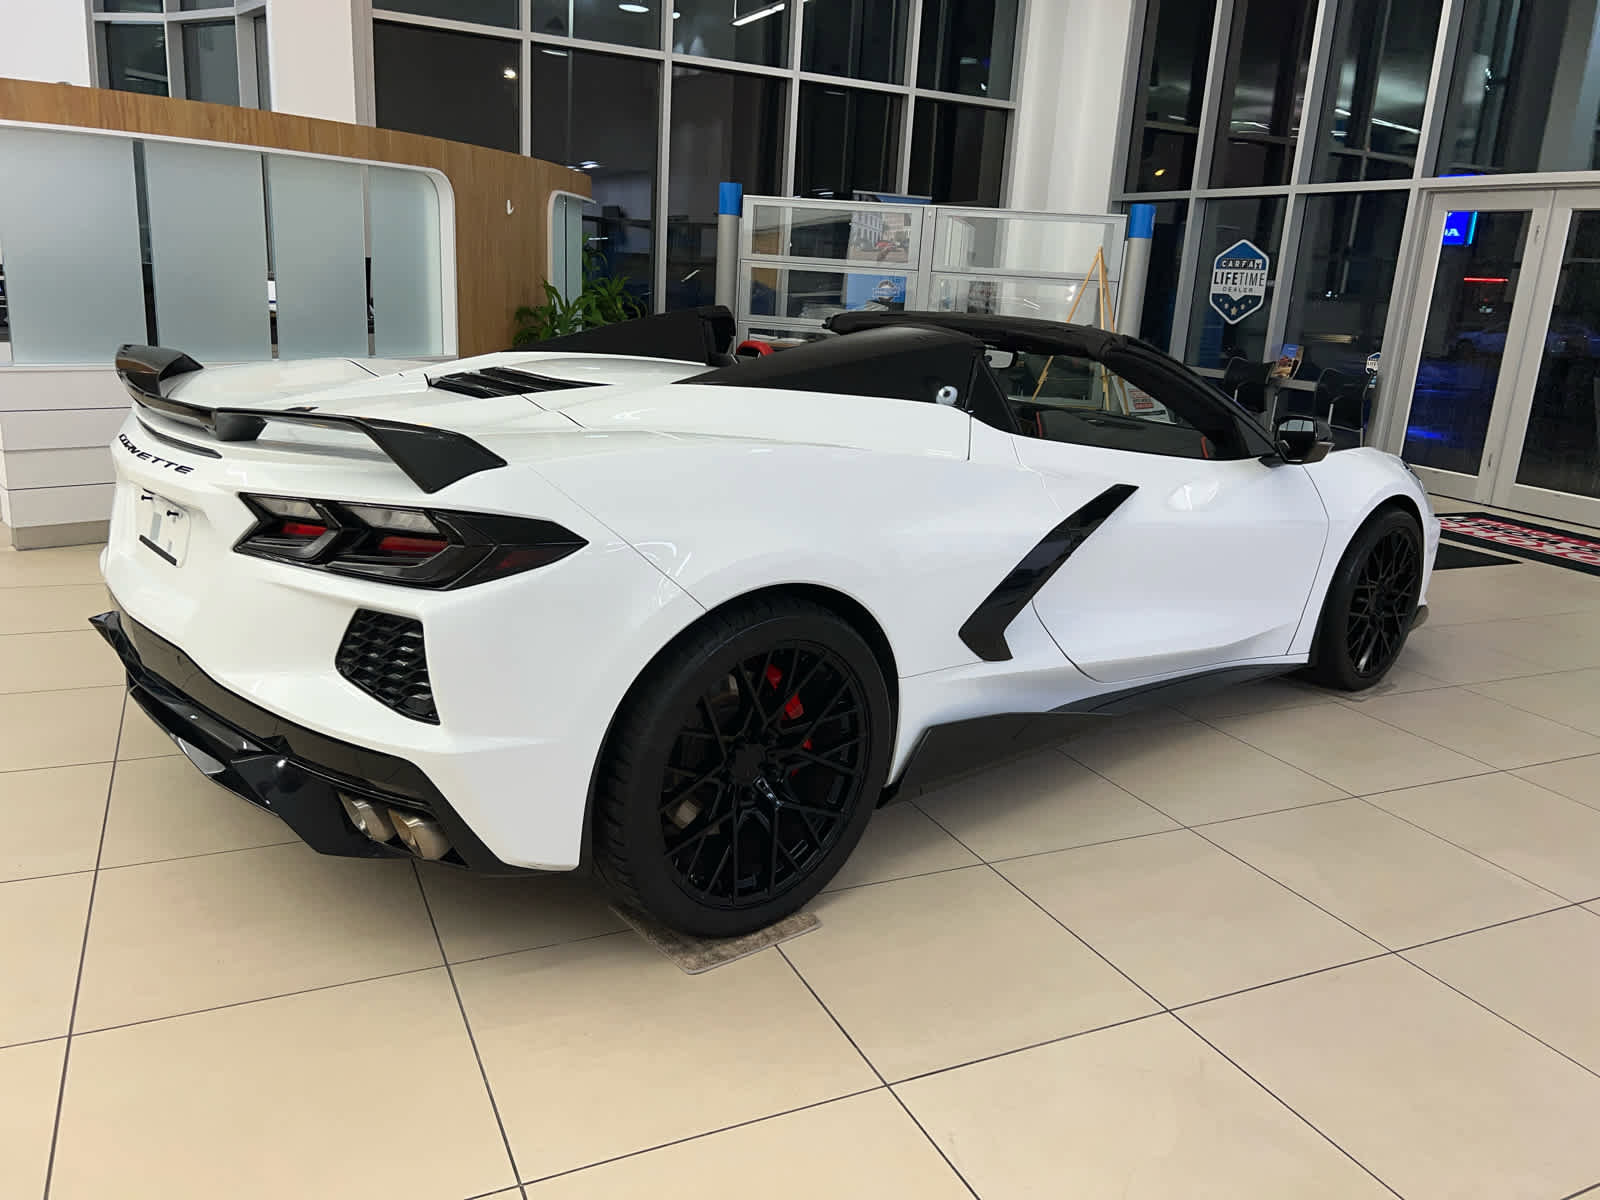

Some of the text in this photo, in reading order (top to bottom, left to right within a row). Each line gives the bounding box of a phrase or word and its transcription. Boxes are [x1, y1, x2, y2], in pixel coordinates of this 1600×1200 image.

[1221, 259, 1263, 270] CARFAX
[1213, 271, 1266, 287] LIFETIME
[118, 433, 195, 475] CORVETTE
